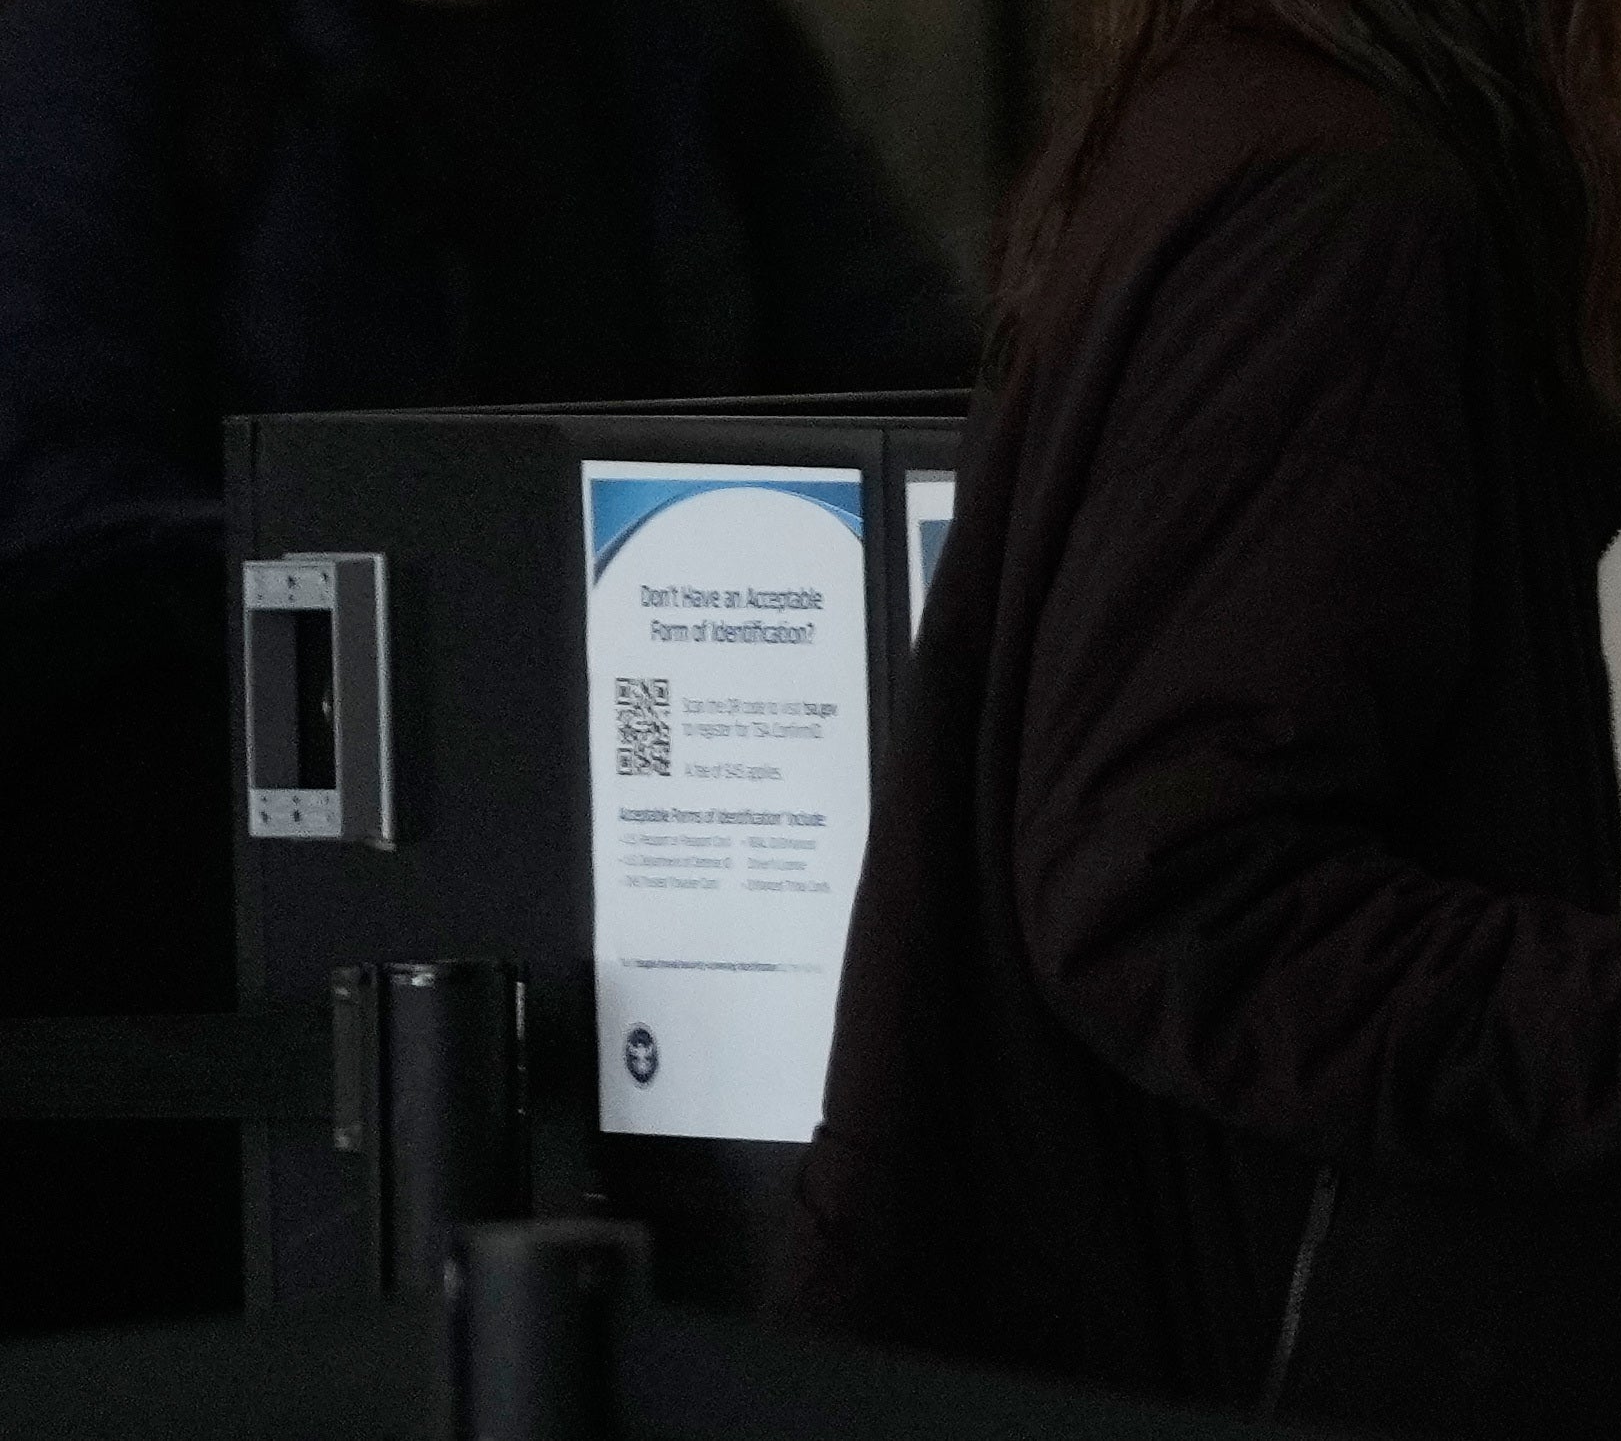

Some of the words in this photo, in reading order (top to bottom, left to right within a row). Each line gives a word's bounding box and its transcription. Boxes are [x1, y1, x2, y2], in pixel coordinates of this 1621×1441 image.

[640, 584, 679, 608] Don't
[682, 585, 720, 609] Have
[724, 590, 741, 609] an
[746, 585, 824, 613] Acceptable
[650, 619, 689, 643] Form
[692, 619, 708, 643] of
[710, 619, 815, 644] Identification?
